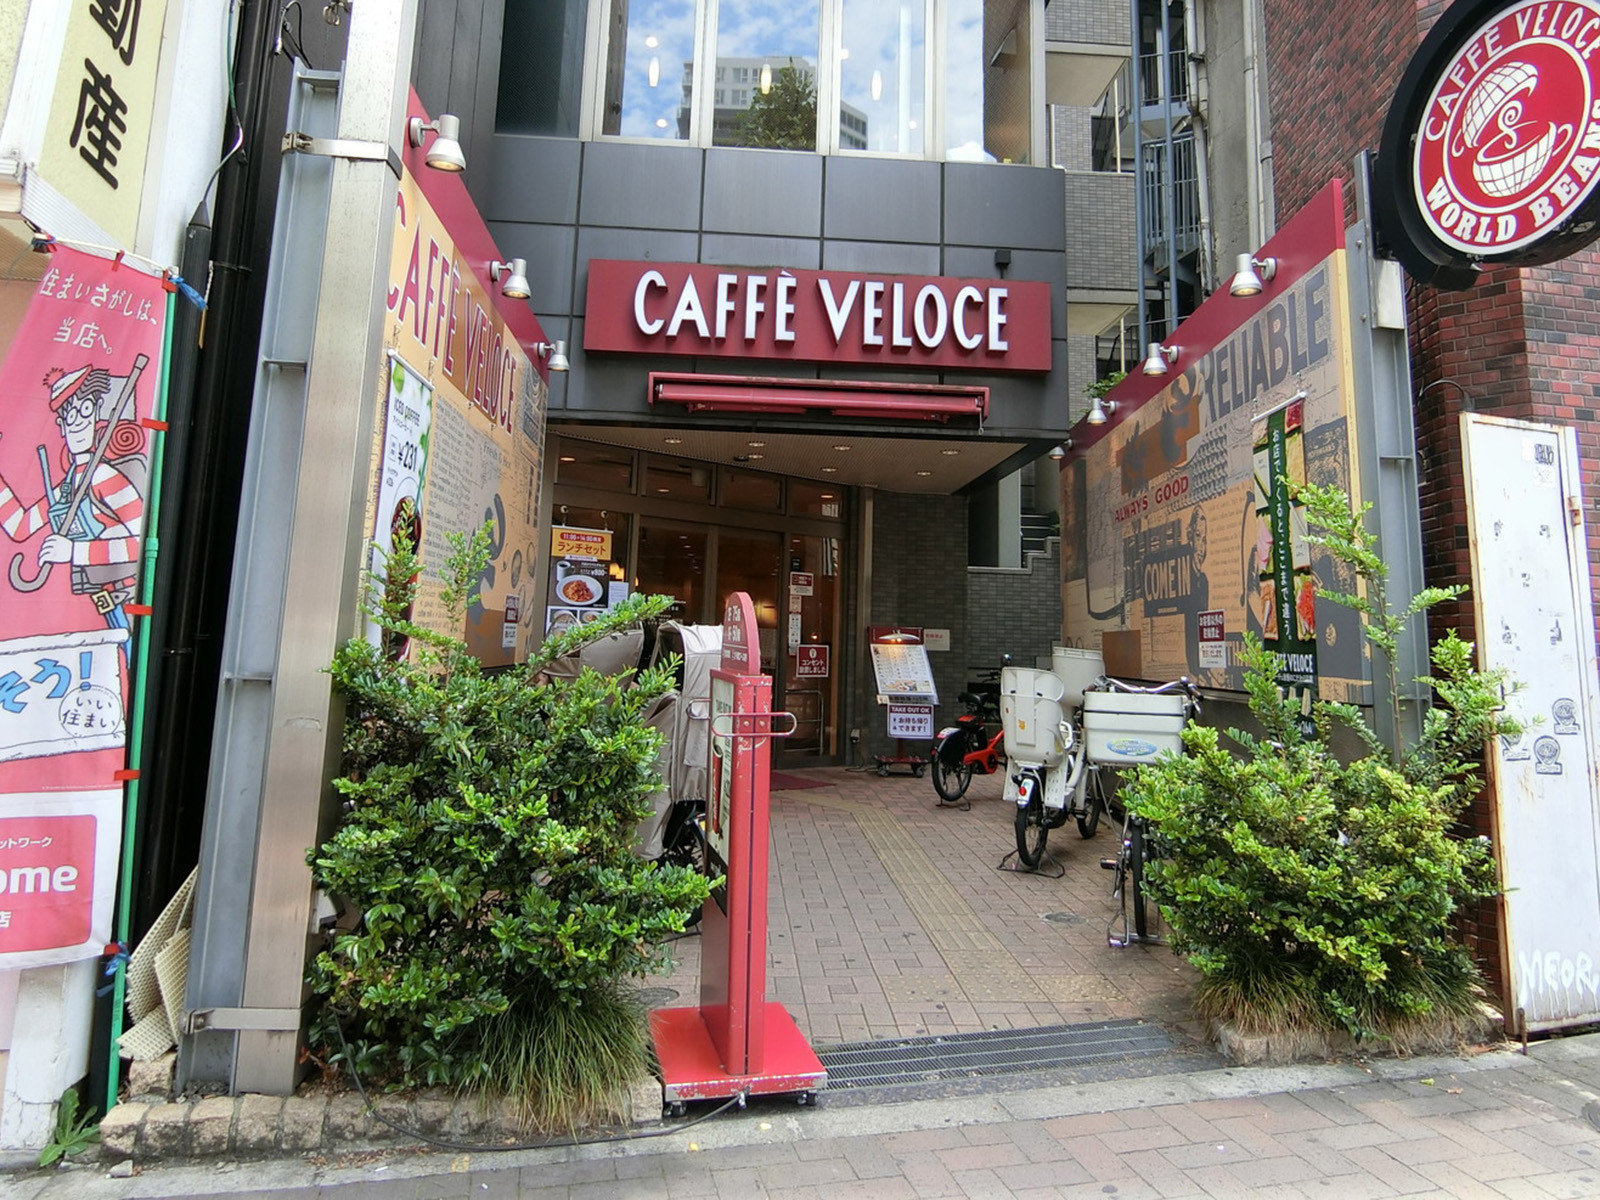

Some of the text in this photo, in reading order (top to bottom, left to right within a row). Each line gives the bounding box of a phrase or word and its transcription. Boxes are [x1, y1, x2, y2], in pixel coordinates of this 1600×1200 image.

[1427, 176, 1517, 244] WORLD
[40, 268, 157, 325] 住まいさがしは、
[634, 269, 1009, 352] CAFFÈ VELOCE
[53, 317, 113, 354] 当店へ。
[1201, 271, 1329, 428] RELIABLE
[465, 288, 518, 435] VELOCE
[1114, 476, 1189, 524] ALWAYS GOOD
[557, 541, 606, 555] ランチセット
[1144, 554, 1192, 601] COME IN
[1287, 653, 1314, 673] VELOCE
[62, 709, 116, 728] 住まい
[76, 696, 112, 710] いい
